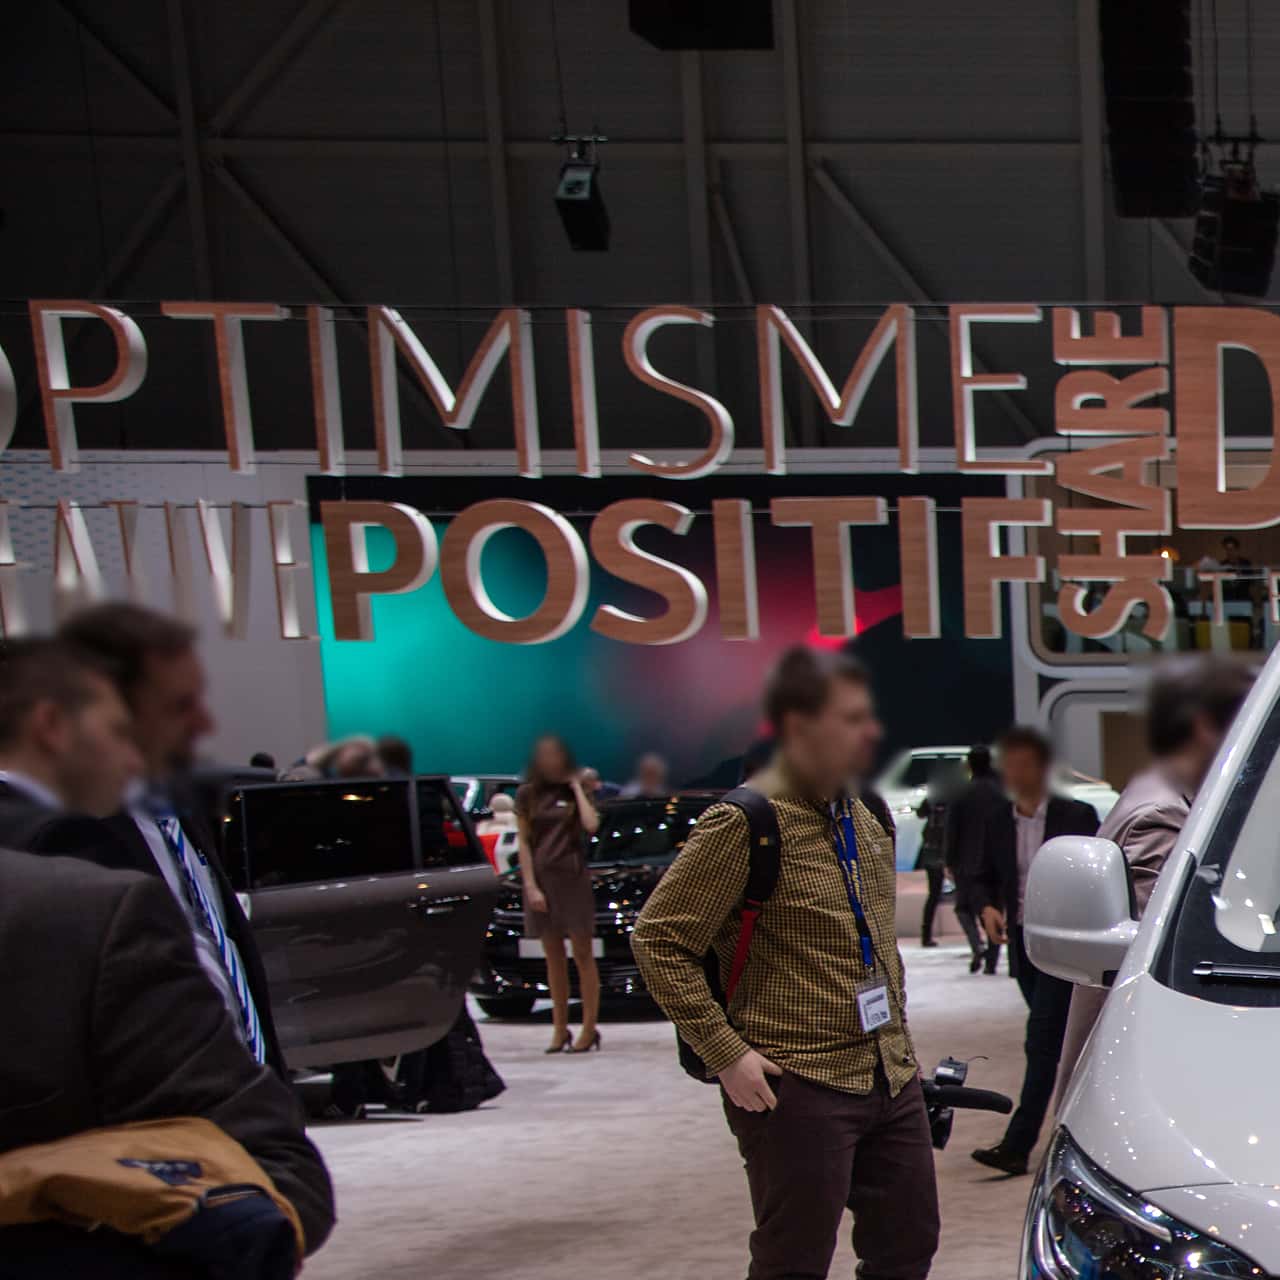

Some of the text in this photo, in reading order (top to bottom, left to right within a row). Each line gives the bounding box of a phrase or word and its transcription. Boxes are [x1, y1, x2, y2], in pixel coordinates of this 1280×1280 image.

[0, 300, 1053, 480] PTIMISME
[1052, 305, 1172, 641] SHARE
[320, 497, 1052, 645] POSITIF
